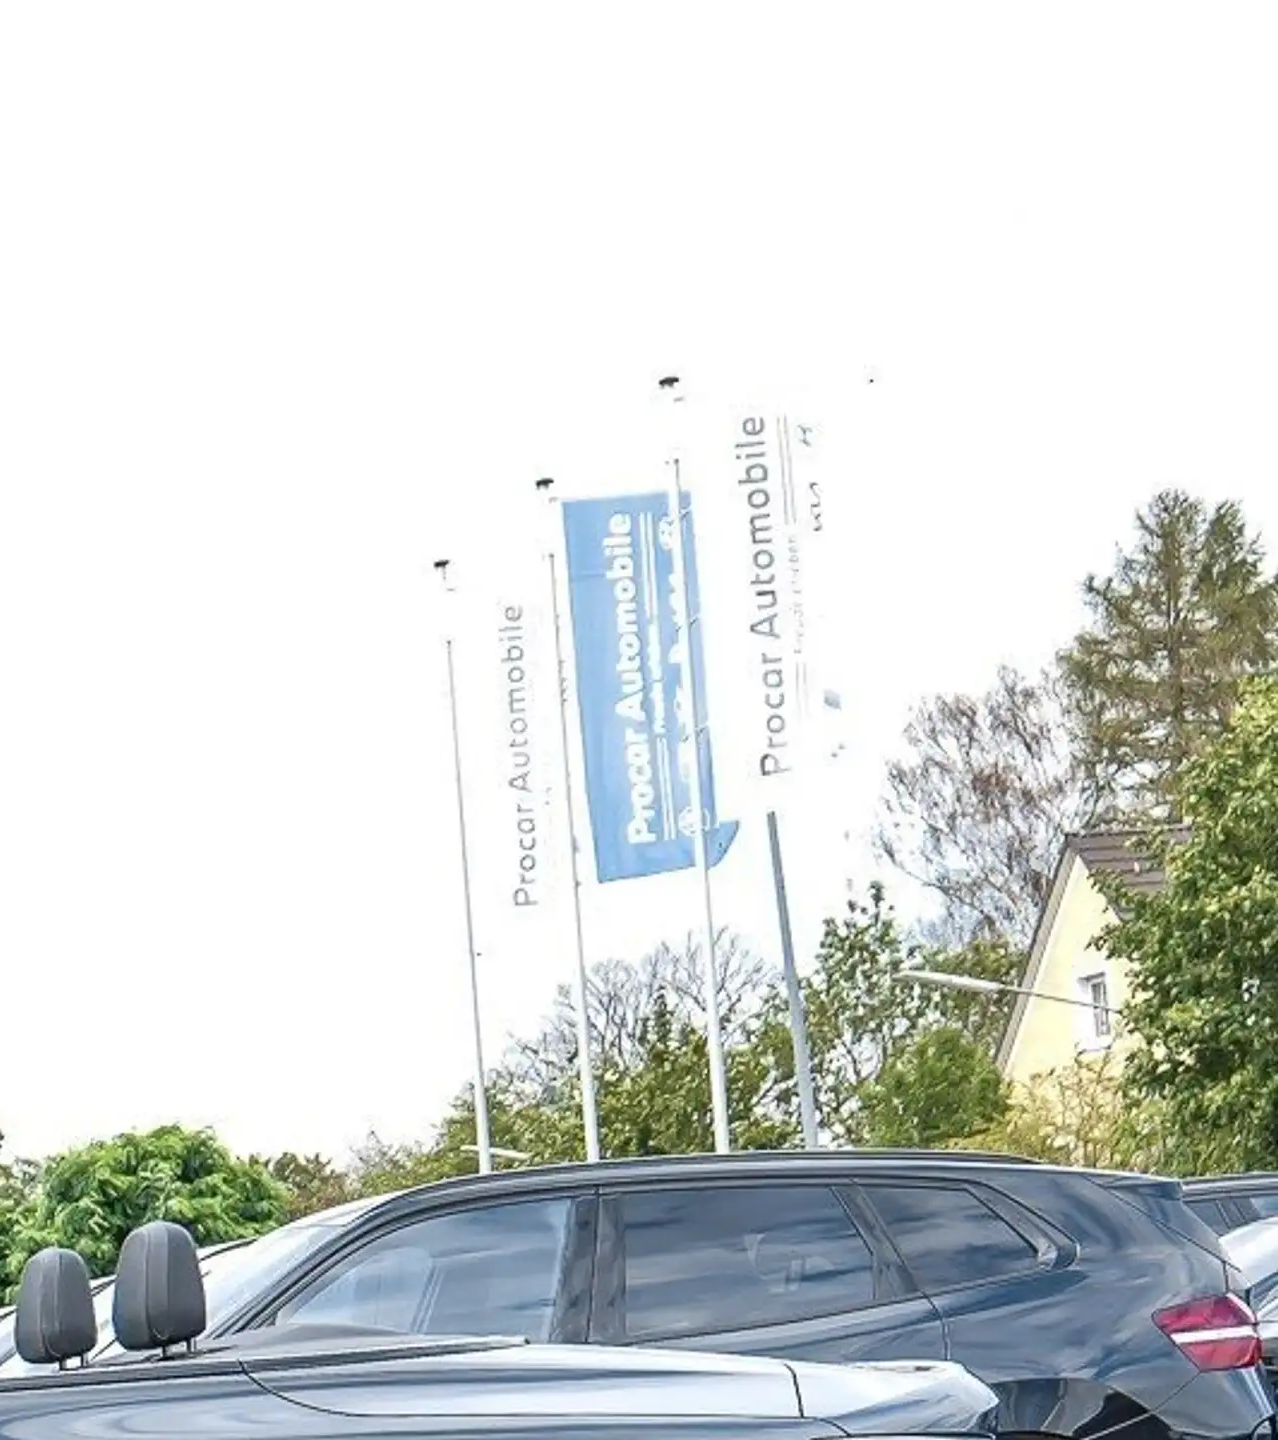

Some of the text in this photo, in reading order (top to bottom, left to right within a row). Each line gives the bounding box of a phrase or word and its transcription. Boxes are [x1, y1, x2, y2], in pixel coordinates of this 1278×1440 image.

[602, 512, 648, 725] Automobile
[735, 415, 791, 778] Procar Automobile
[499, 604, 537, 907] Procar Automobile
[624, 730, 657, 844] Procar
